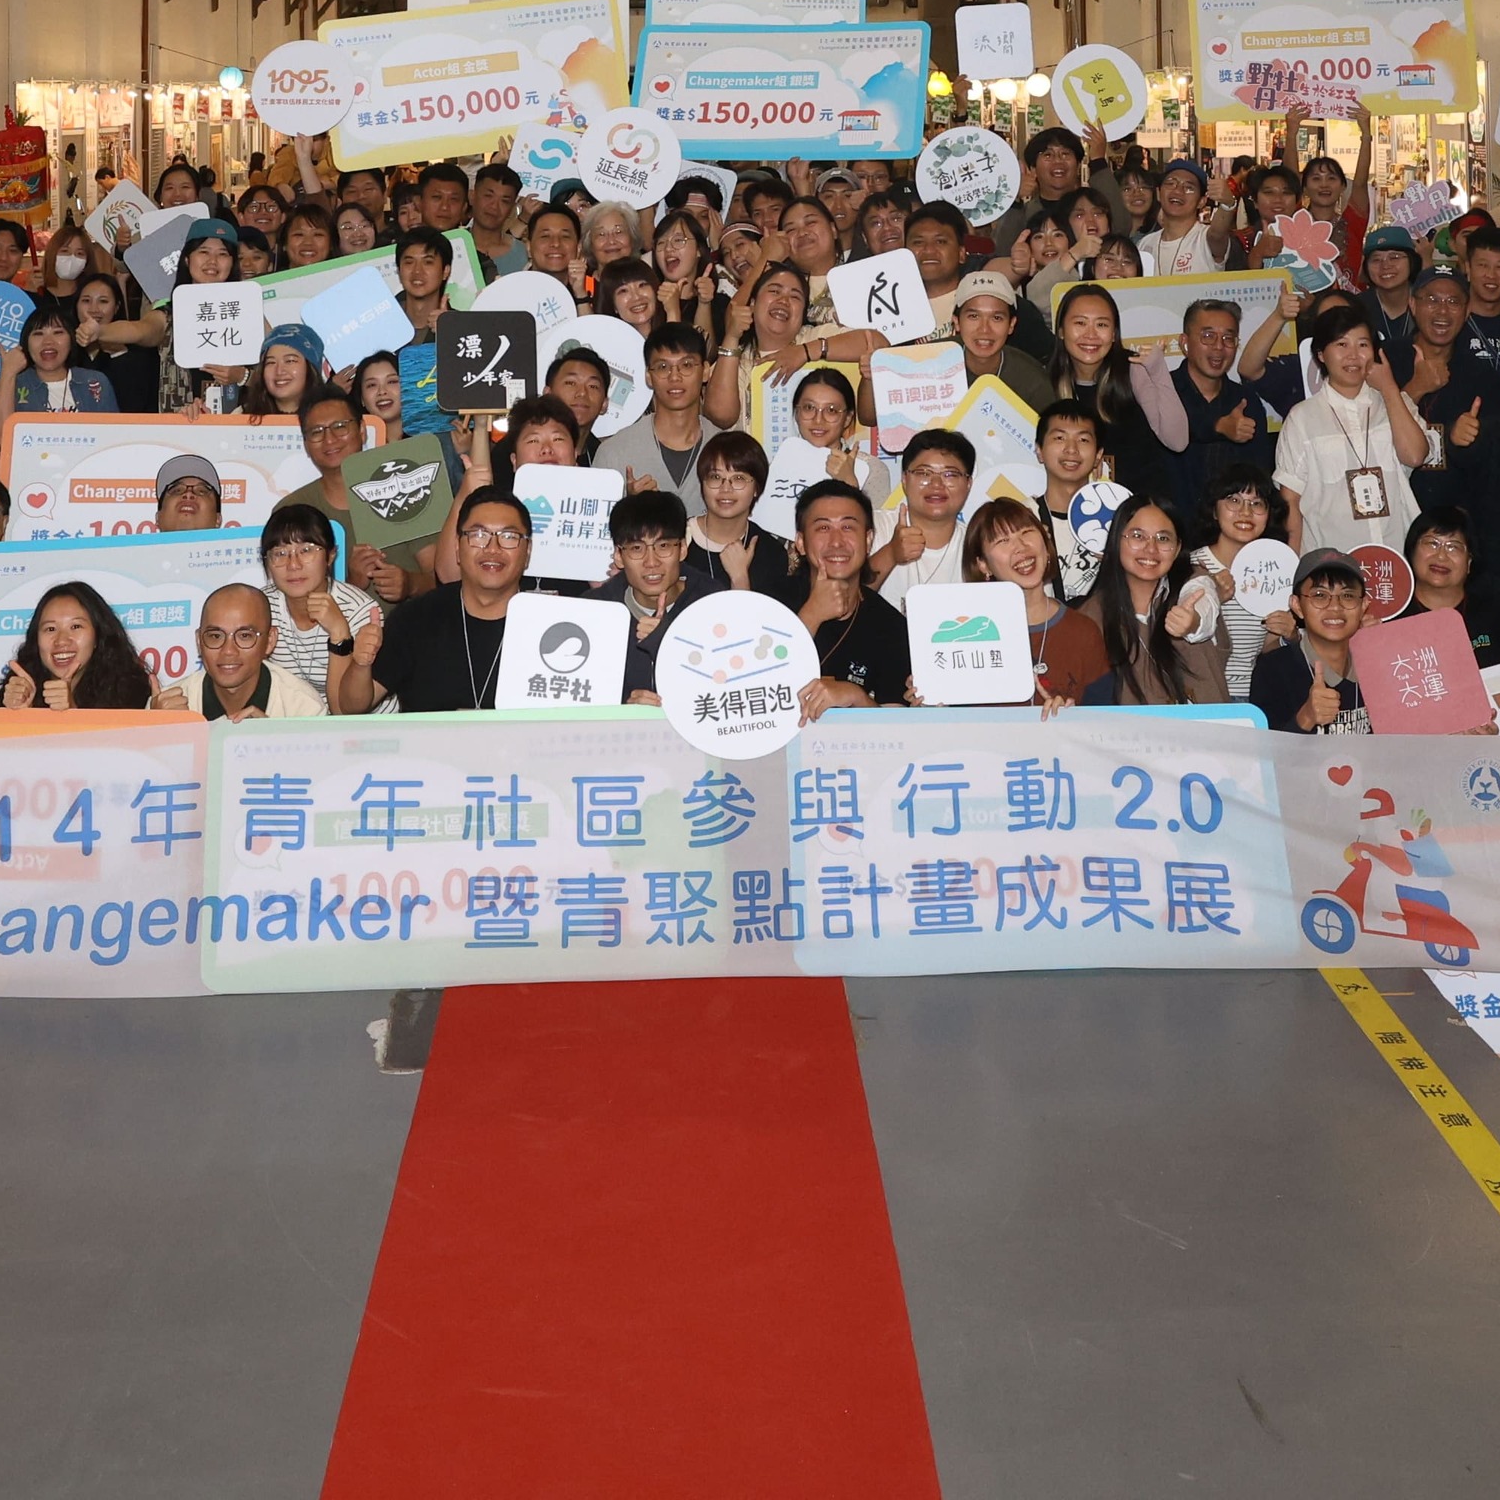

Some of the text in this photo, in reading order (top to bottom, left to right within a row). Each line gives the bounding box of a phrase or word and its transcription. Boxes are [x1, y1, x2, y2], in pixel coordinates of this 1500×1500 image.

[413, 58, 490, 79] Actor組 金獎
[688, 72, 815, 89] Changemaker組 銀獎
[595, 157, 649, 190] 延長線
[195, 300, 241, 323] 嘉譯
[196, 327, 243, 350] 文化
[887, 382, 955, 406] 南澳漫步
[148, 605, 186, 625] 銀獎
[933, 649, 1005, 670] 冬瓜山塾
[526, 673, 592, 703] 魚学社
[693, 684, 795, 724] 美得冒泡
[717, 719, 778, 737] BEAUTIFOOL
[465, 853, 1242, 950] 暨青聚點計畫成果展
